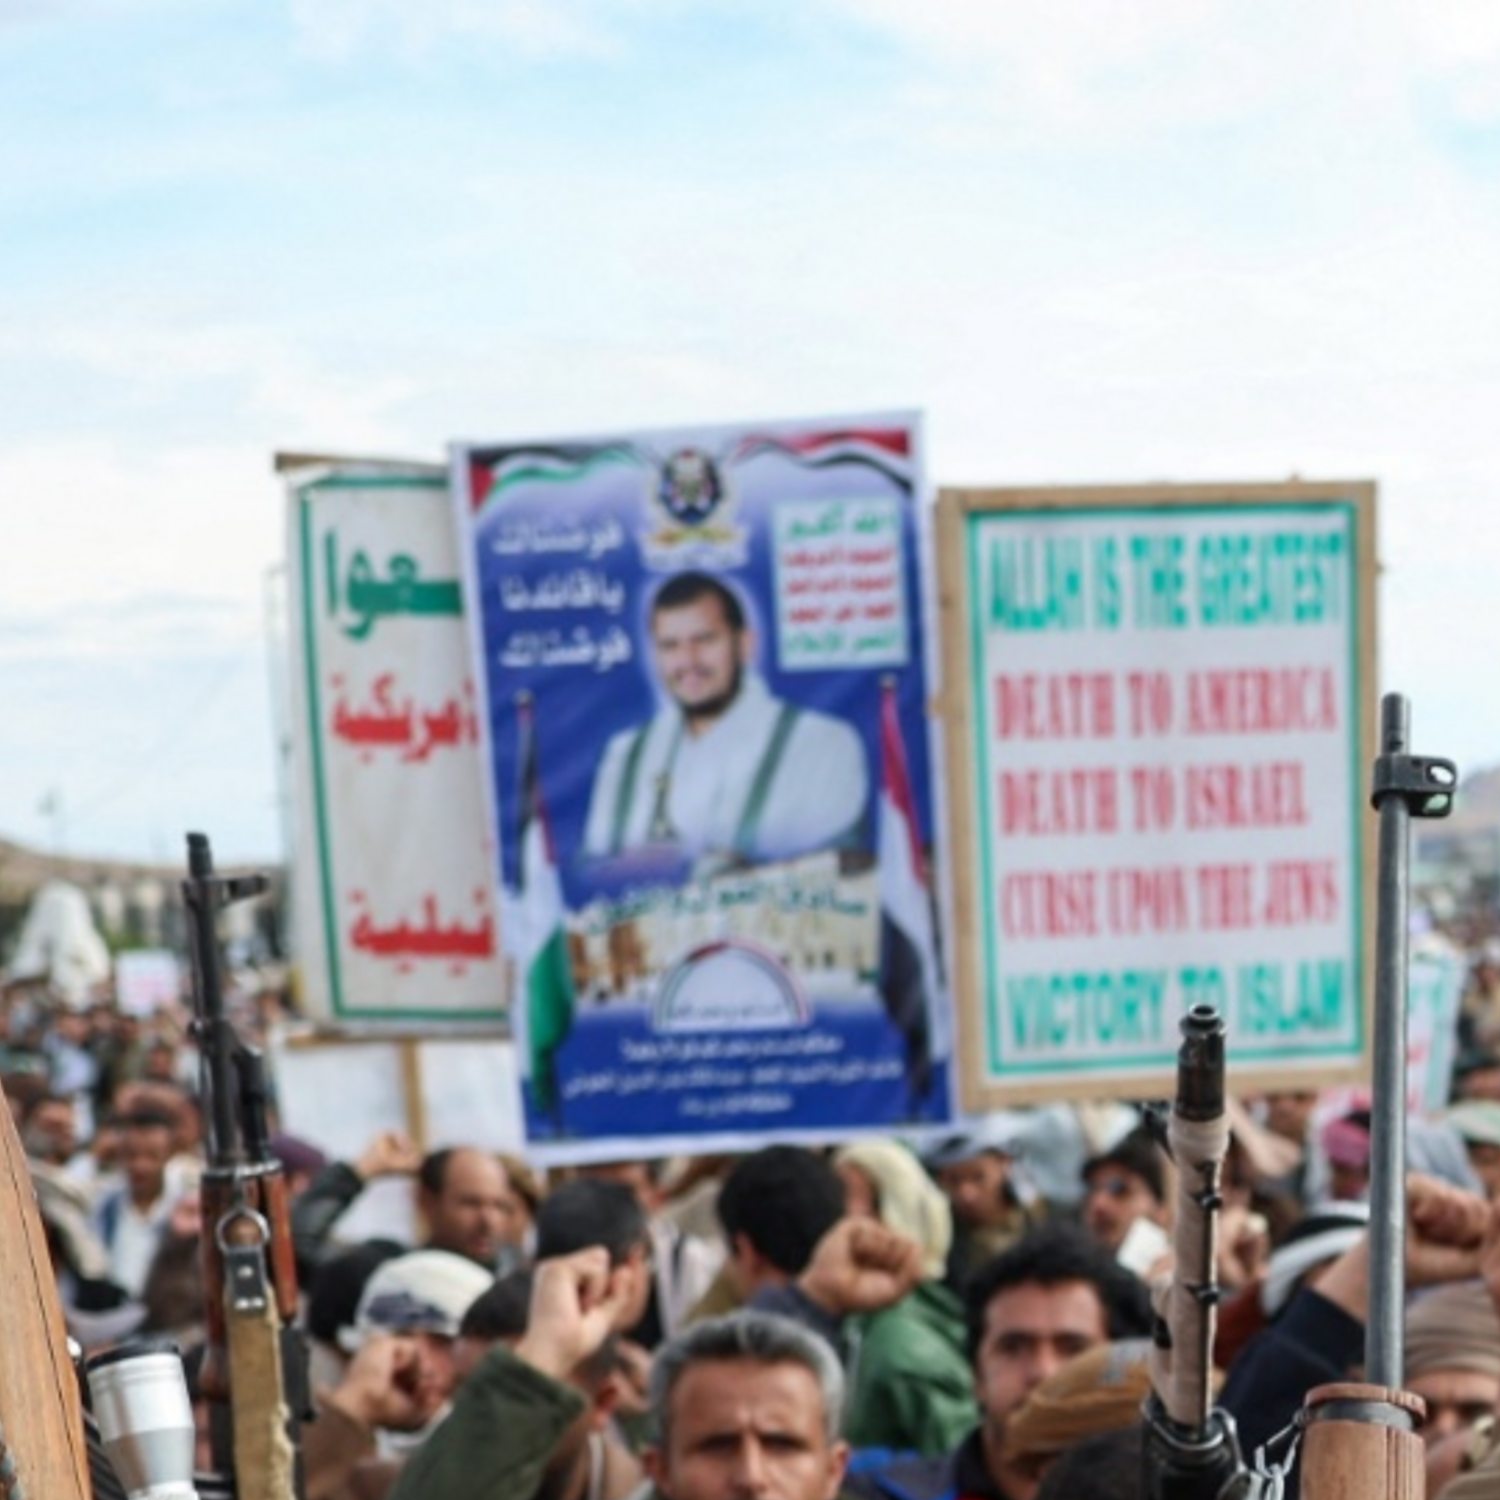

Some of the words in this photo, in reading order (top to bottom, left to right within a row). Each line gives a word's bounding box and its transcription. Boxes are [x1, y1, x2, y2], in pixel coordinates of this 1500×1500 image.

[991, 535, 1085, 632] ALLAH
[1094, 535, 1121, 630] IS
[1127, 534, 1189, 629] THE
[1197, 530, 1341, 628] GREATEST
[993, 672, 1116, 740] DEATH
[1126, 671, 1174, 739] TO
[1185, 665, 1338, 737] AMERICA
[996, 767, 1121, 836] DEATH
[1130, 764, 1177, 833] TO
[1183, 761, 1307, 831] ISRAEL
[1000, 868, 1099, 939] CURSE
[1103, 864, 1189, 934] UPON
[1195, 861, 1256, 931] THE
[1262, 857, 1340, 929] JEWS
[1004, 969, 1168, 1047] VICTORY
[1236, 958, 1344, 1036] ISLAM
